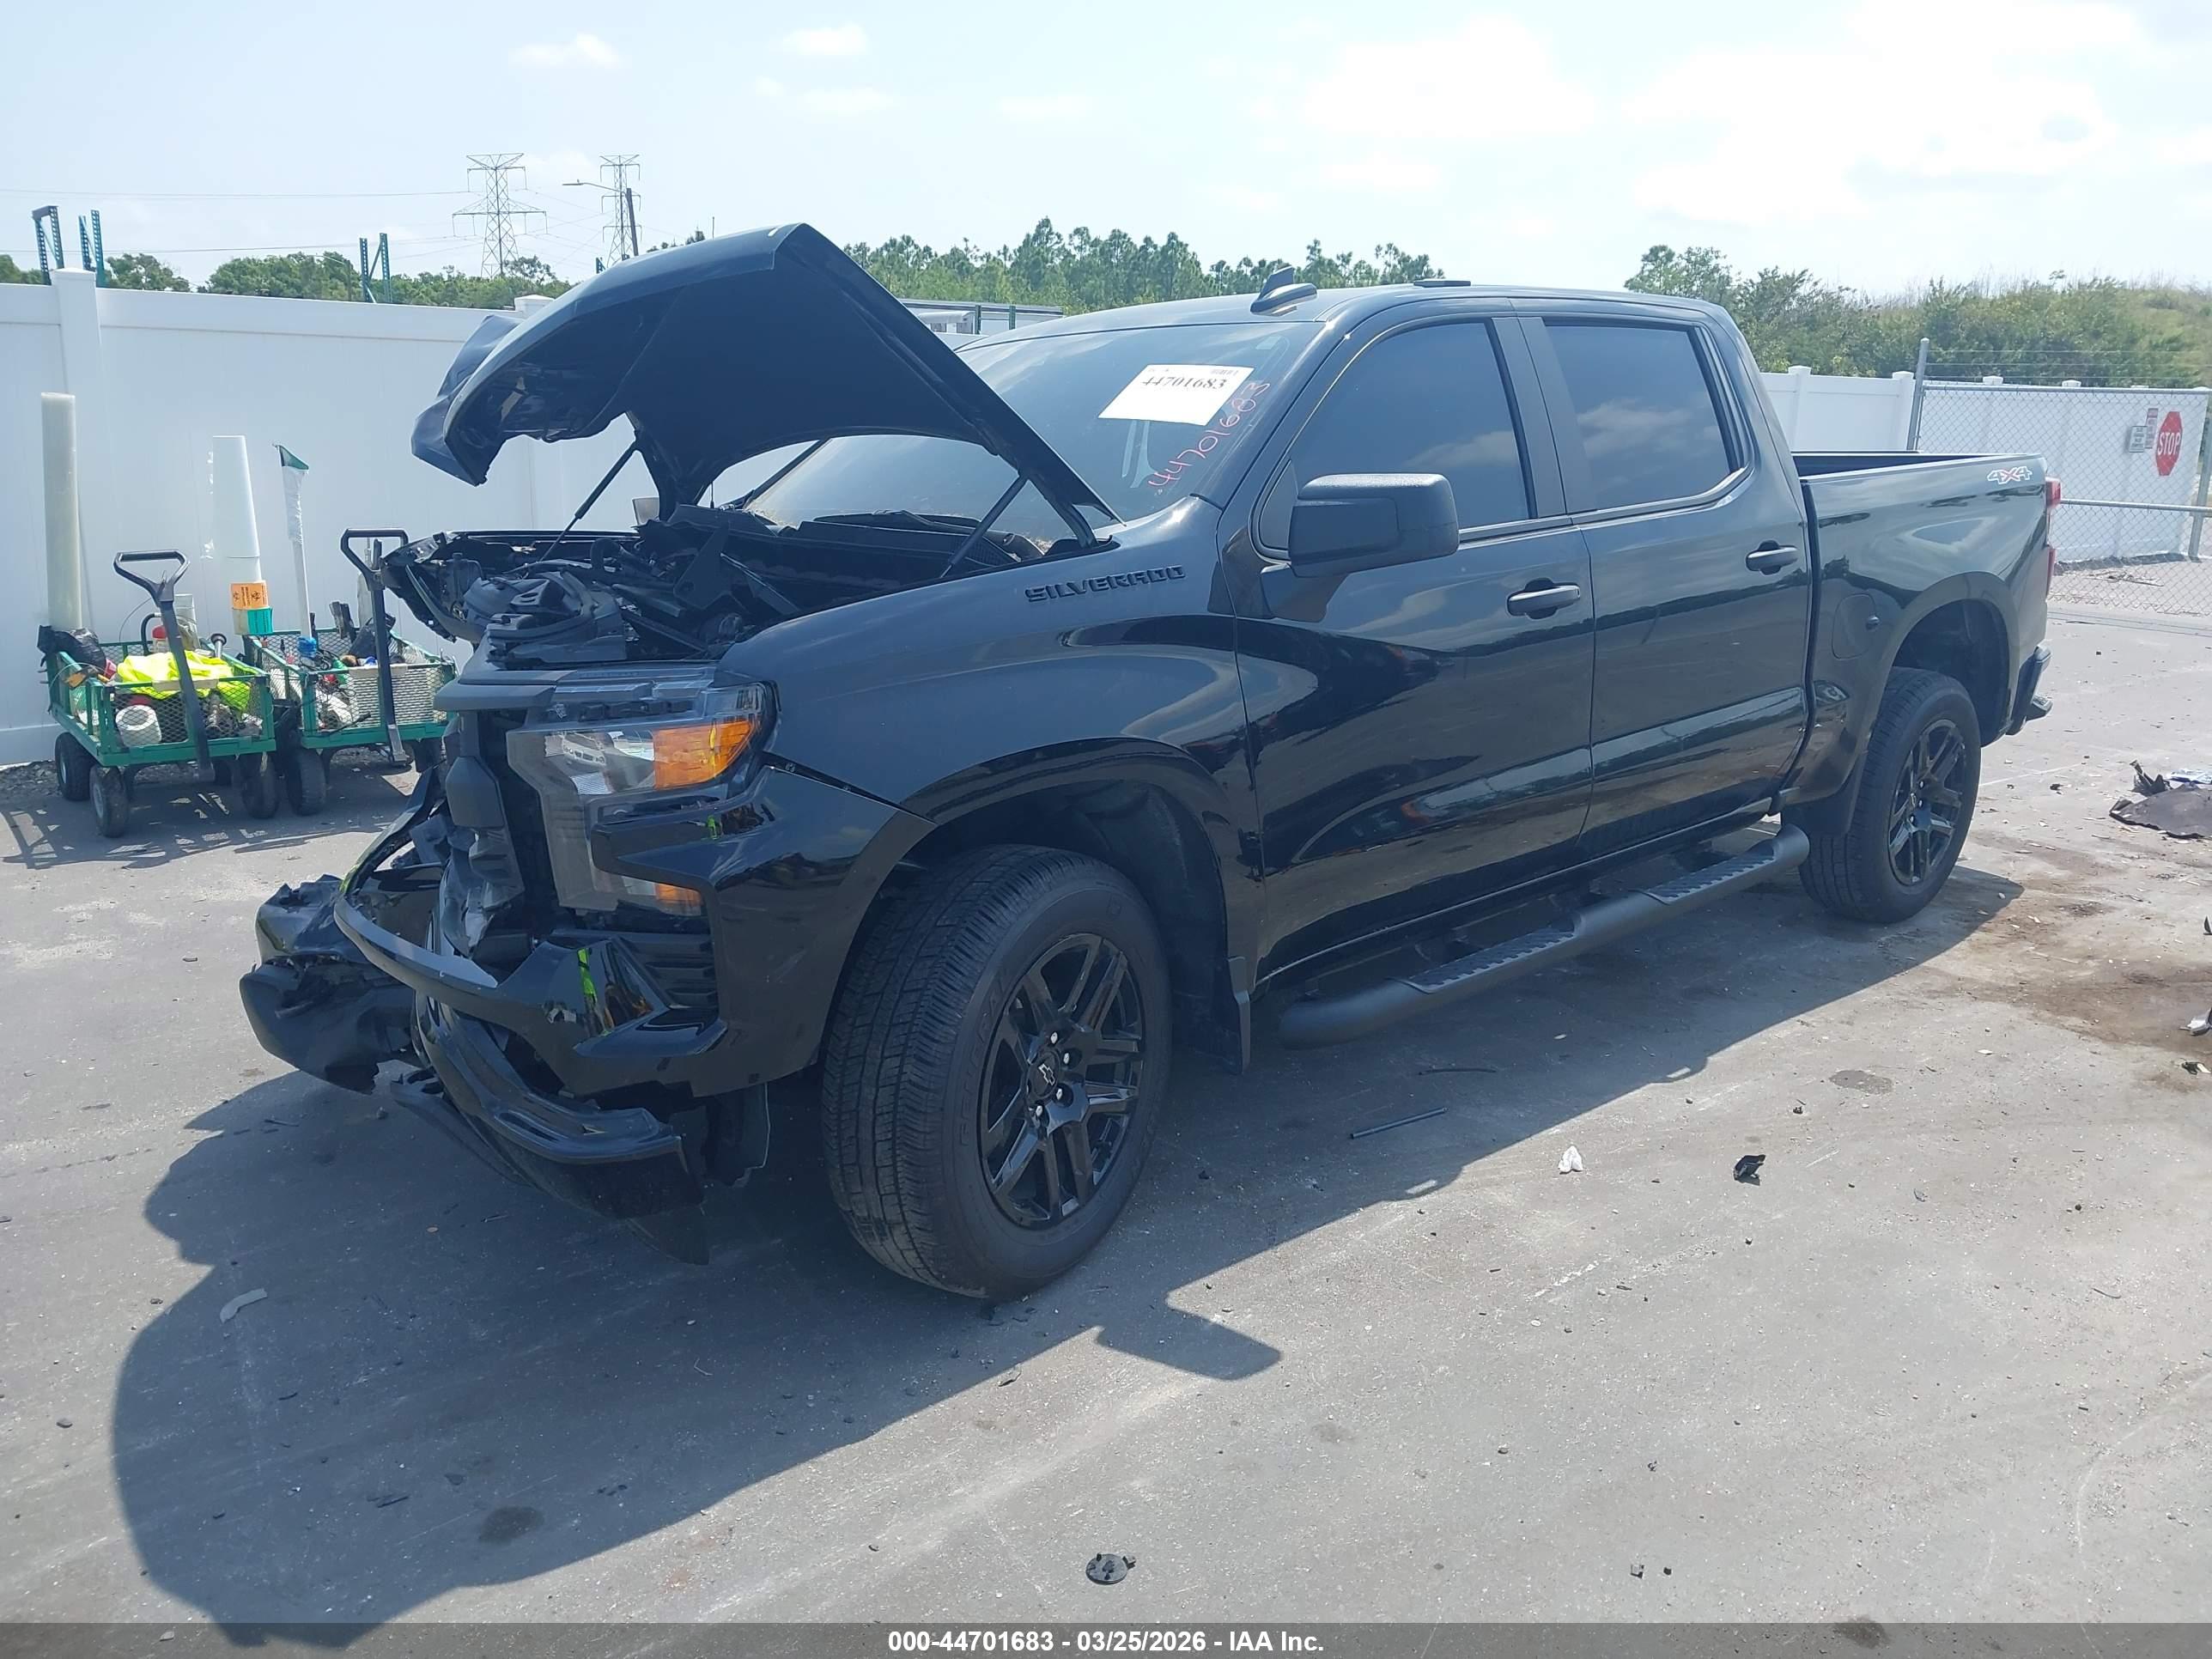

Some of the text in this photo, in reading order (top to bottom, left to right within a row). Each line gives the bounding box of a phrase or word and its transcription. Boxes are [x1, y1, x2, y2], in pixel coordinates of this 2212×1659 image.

[1142, 376, 1227, 389] 44701683
[1147, 381, 1271, 487] 44701683
[2157, 431, 2181, 456] STOP
[1024, 564, 1187, 602] SILVERADO
